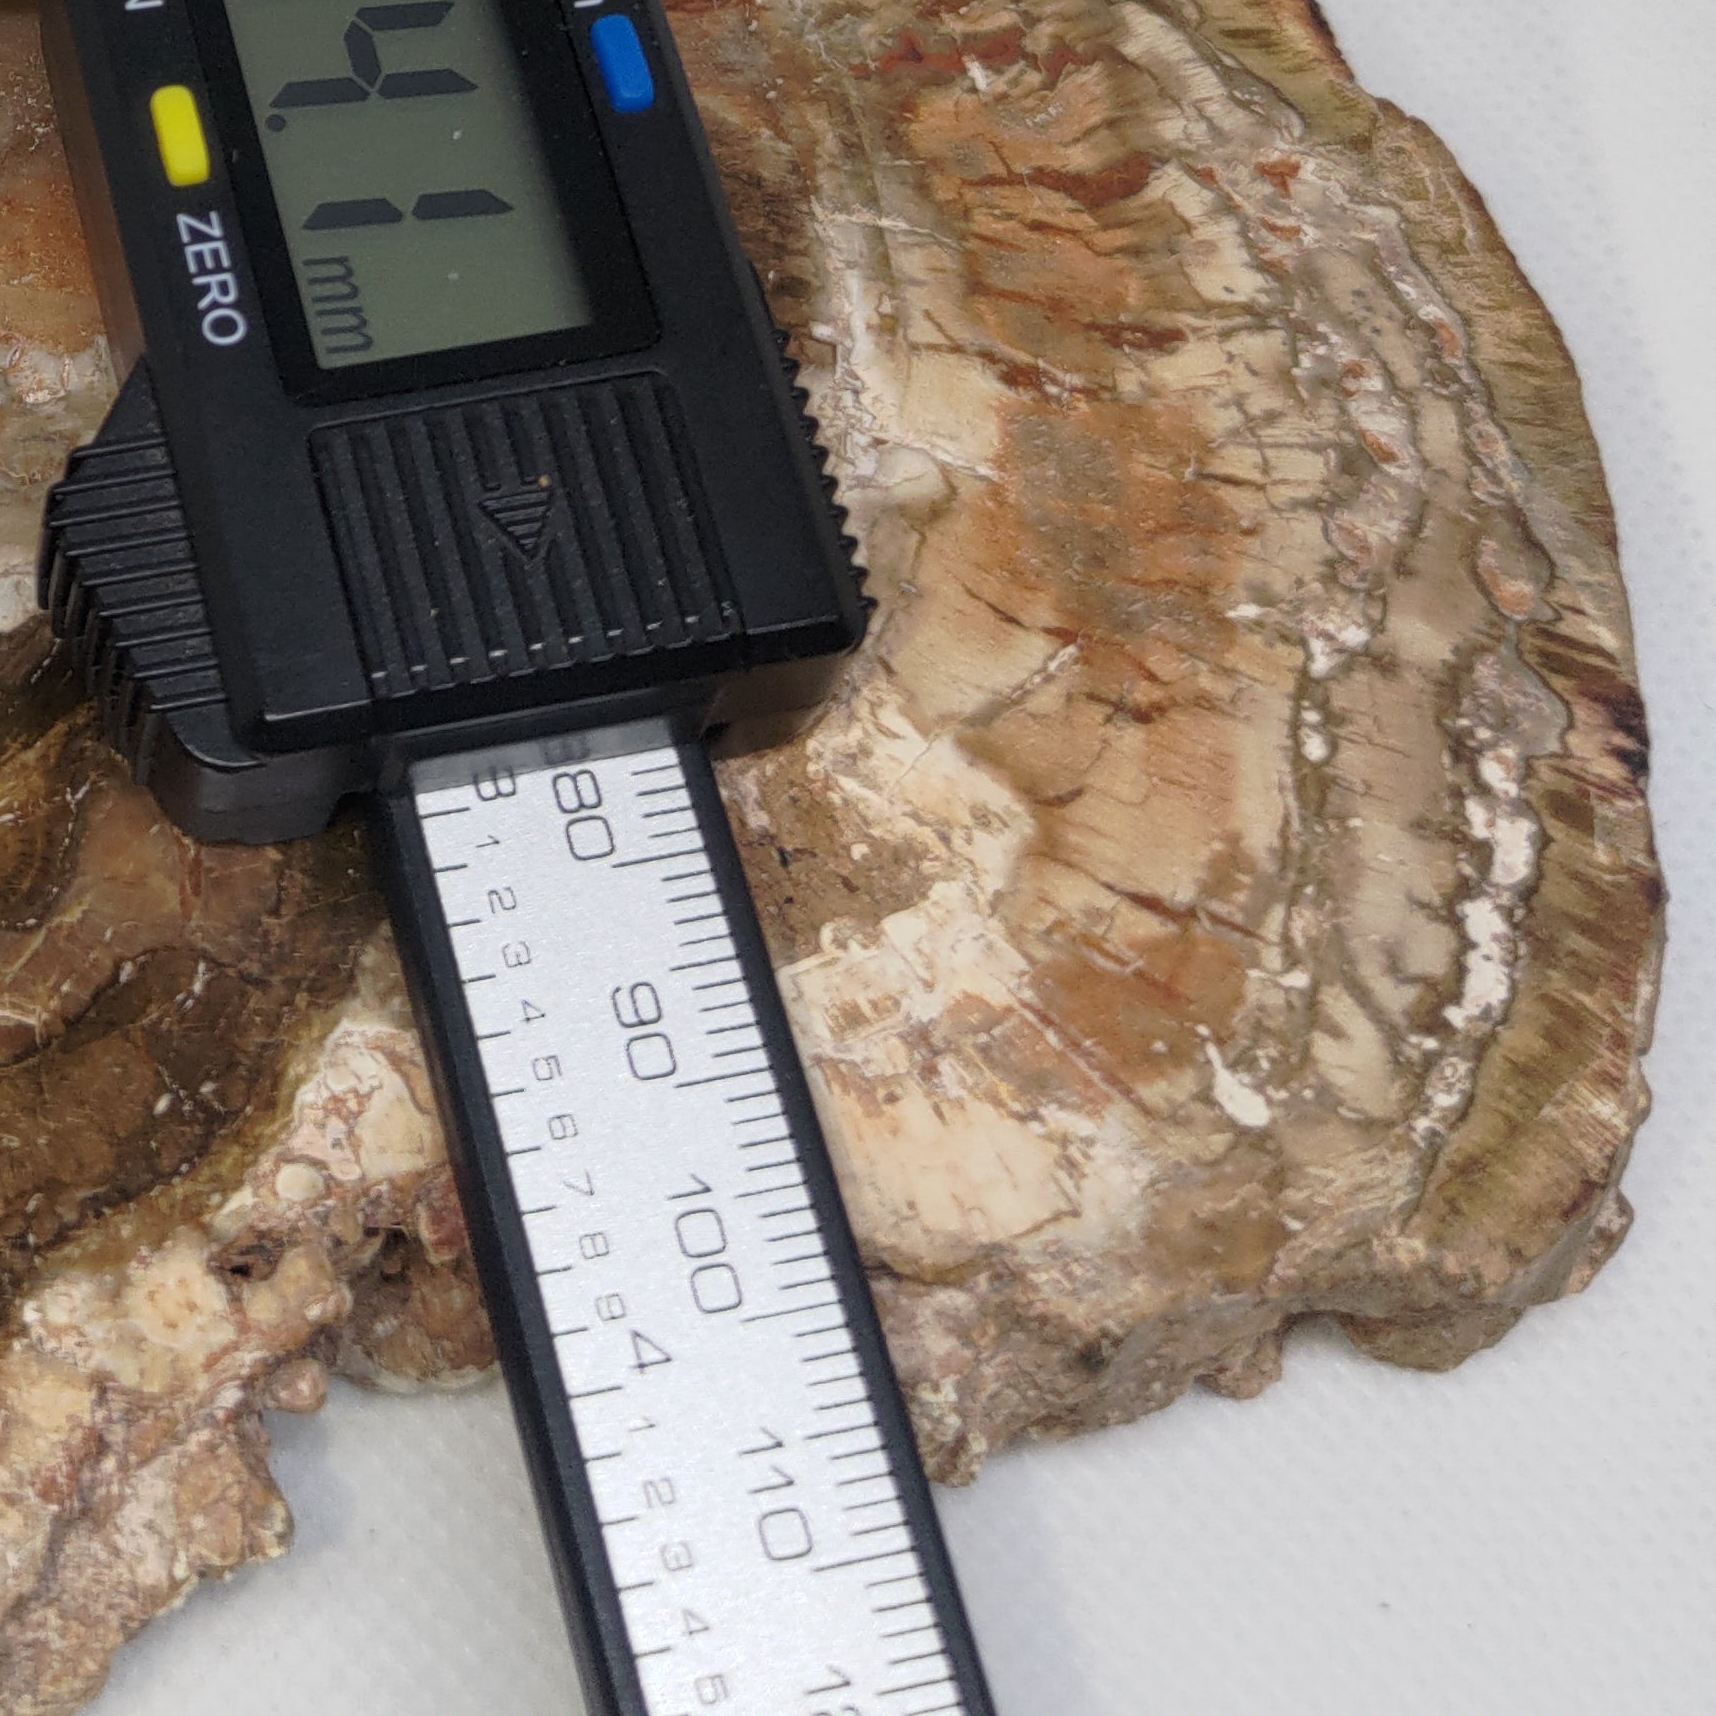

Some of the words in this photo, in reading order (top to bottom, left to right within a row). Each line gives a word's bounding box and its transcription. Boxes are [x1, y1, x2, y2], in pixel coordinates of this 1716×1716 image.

[176, 210, 247, 345] ZERO
[303, 254, 374, 356] mm
[476, 835, 500, 848] 1
[488, 887, 517, 913] 2
[502, 941, 532, 968] 3
[521, 999, 546, 1023] 4
[532, 1055, 563, 1082] 5
[548, 1114, 579, 1141] 6
[562, 1171, 595, 1197] 7
[552, 769, 616, 861] 80
[611, 982, 677, 1081] 90
[667, 1173, 742, 1314] 100
[737, 1426, 813, 1561] 110
[803, 1664, 862, 1716] 1
[579, 1232, 610, 1260] 8
[595, 1293, 627, 1322] 9
[629, 1330, 673, 1373] 4
[628, 1416, 656, 1432] 1
[643, 1477, 676, 1508] 2
[660, 1540, 694, 1572] 3
[682, 1609, 710, 1637] 4
[695, 1674, 729, 1705] 5
